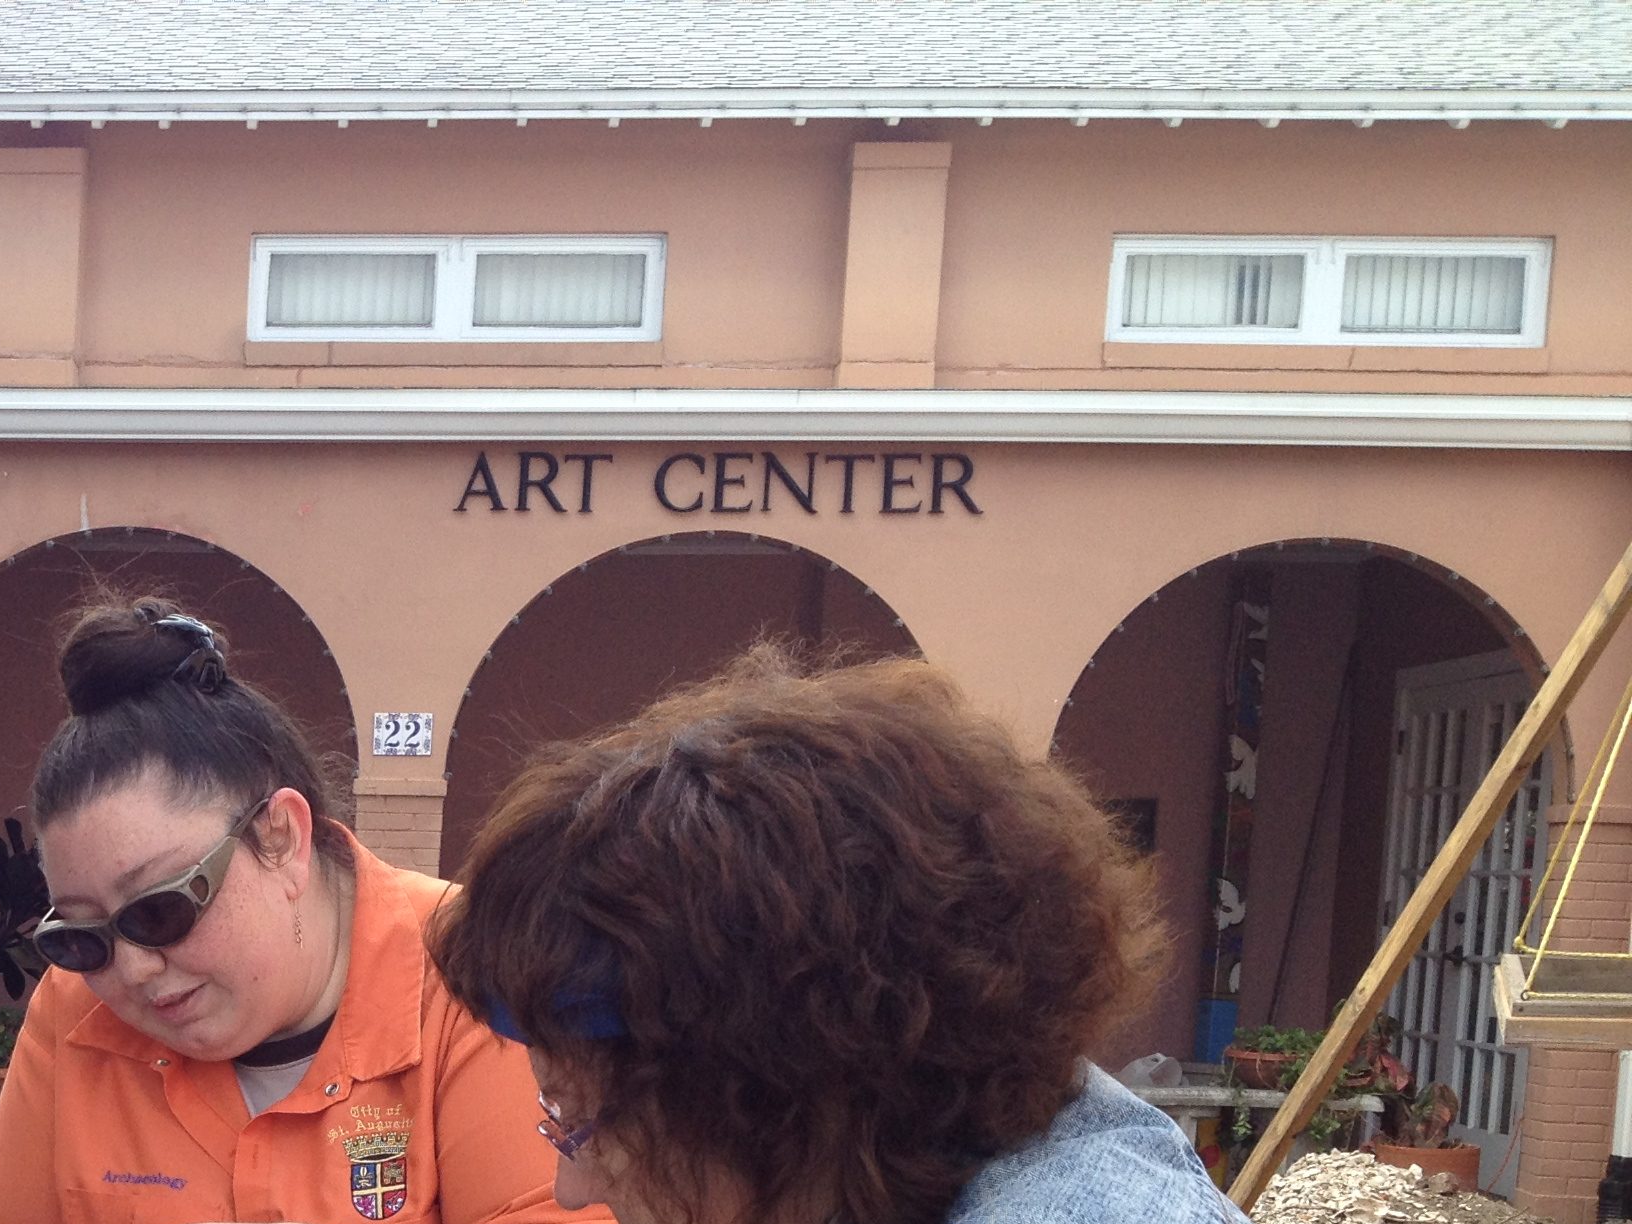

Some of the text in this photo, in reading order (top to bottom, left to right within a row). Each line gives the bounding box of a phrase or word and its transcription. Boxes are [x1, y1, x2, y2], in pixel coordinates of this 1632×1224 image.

[453, 451, 984, 516] ART CENTER
[384, 720, 421, 748] 22
[350, 1104, 402, 1120] City of
